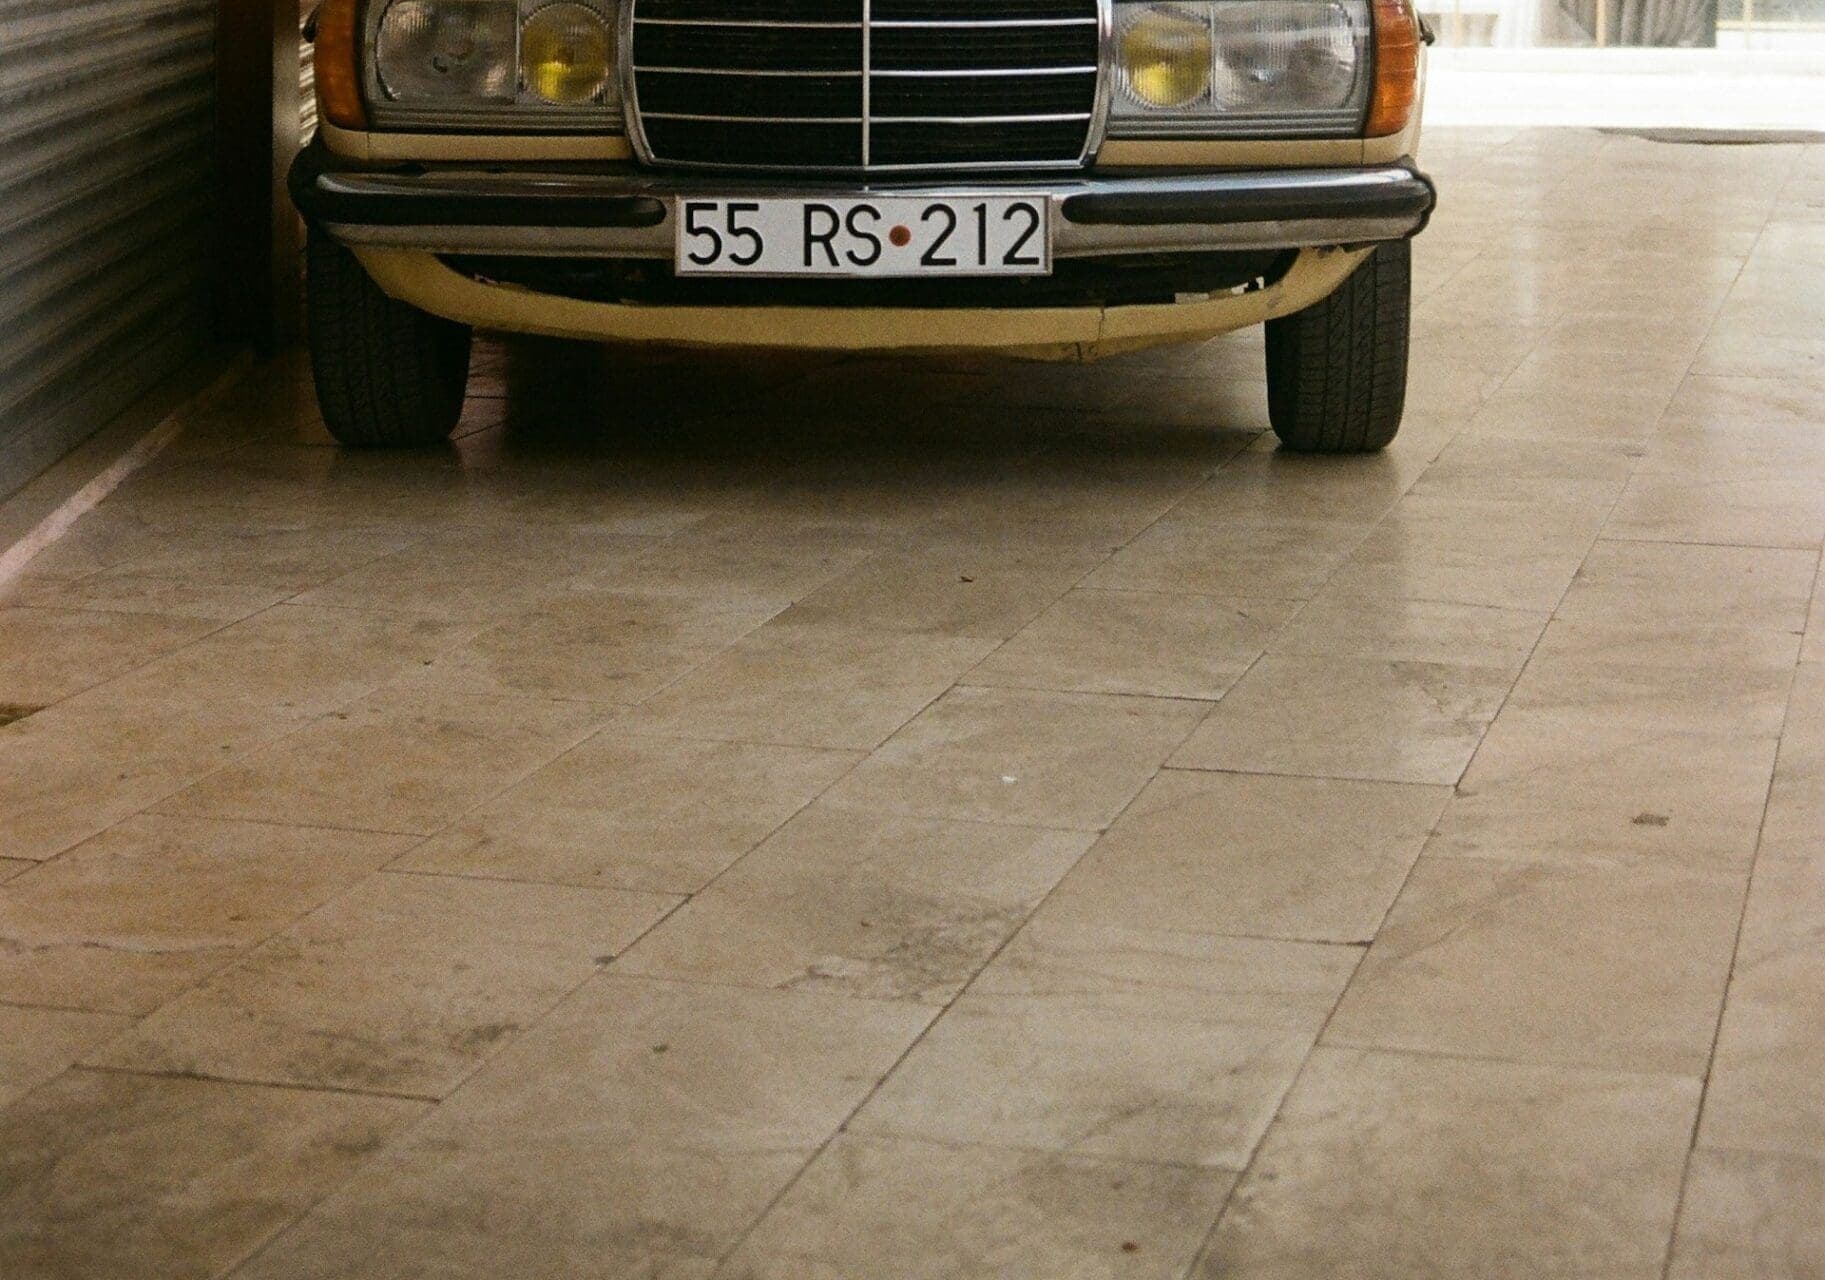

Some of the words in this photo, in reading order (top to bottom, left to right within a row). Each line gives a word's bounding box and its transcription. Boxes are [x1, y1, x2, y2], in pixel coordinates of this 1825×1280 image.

[685, 202, 764, 267] 55
[803, 202, 883, 267] RS
[920, 201, 1041, 267] 212
